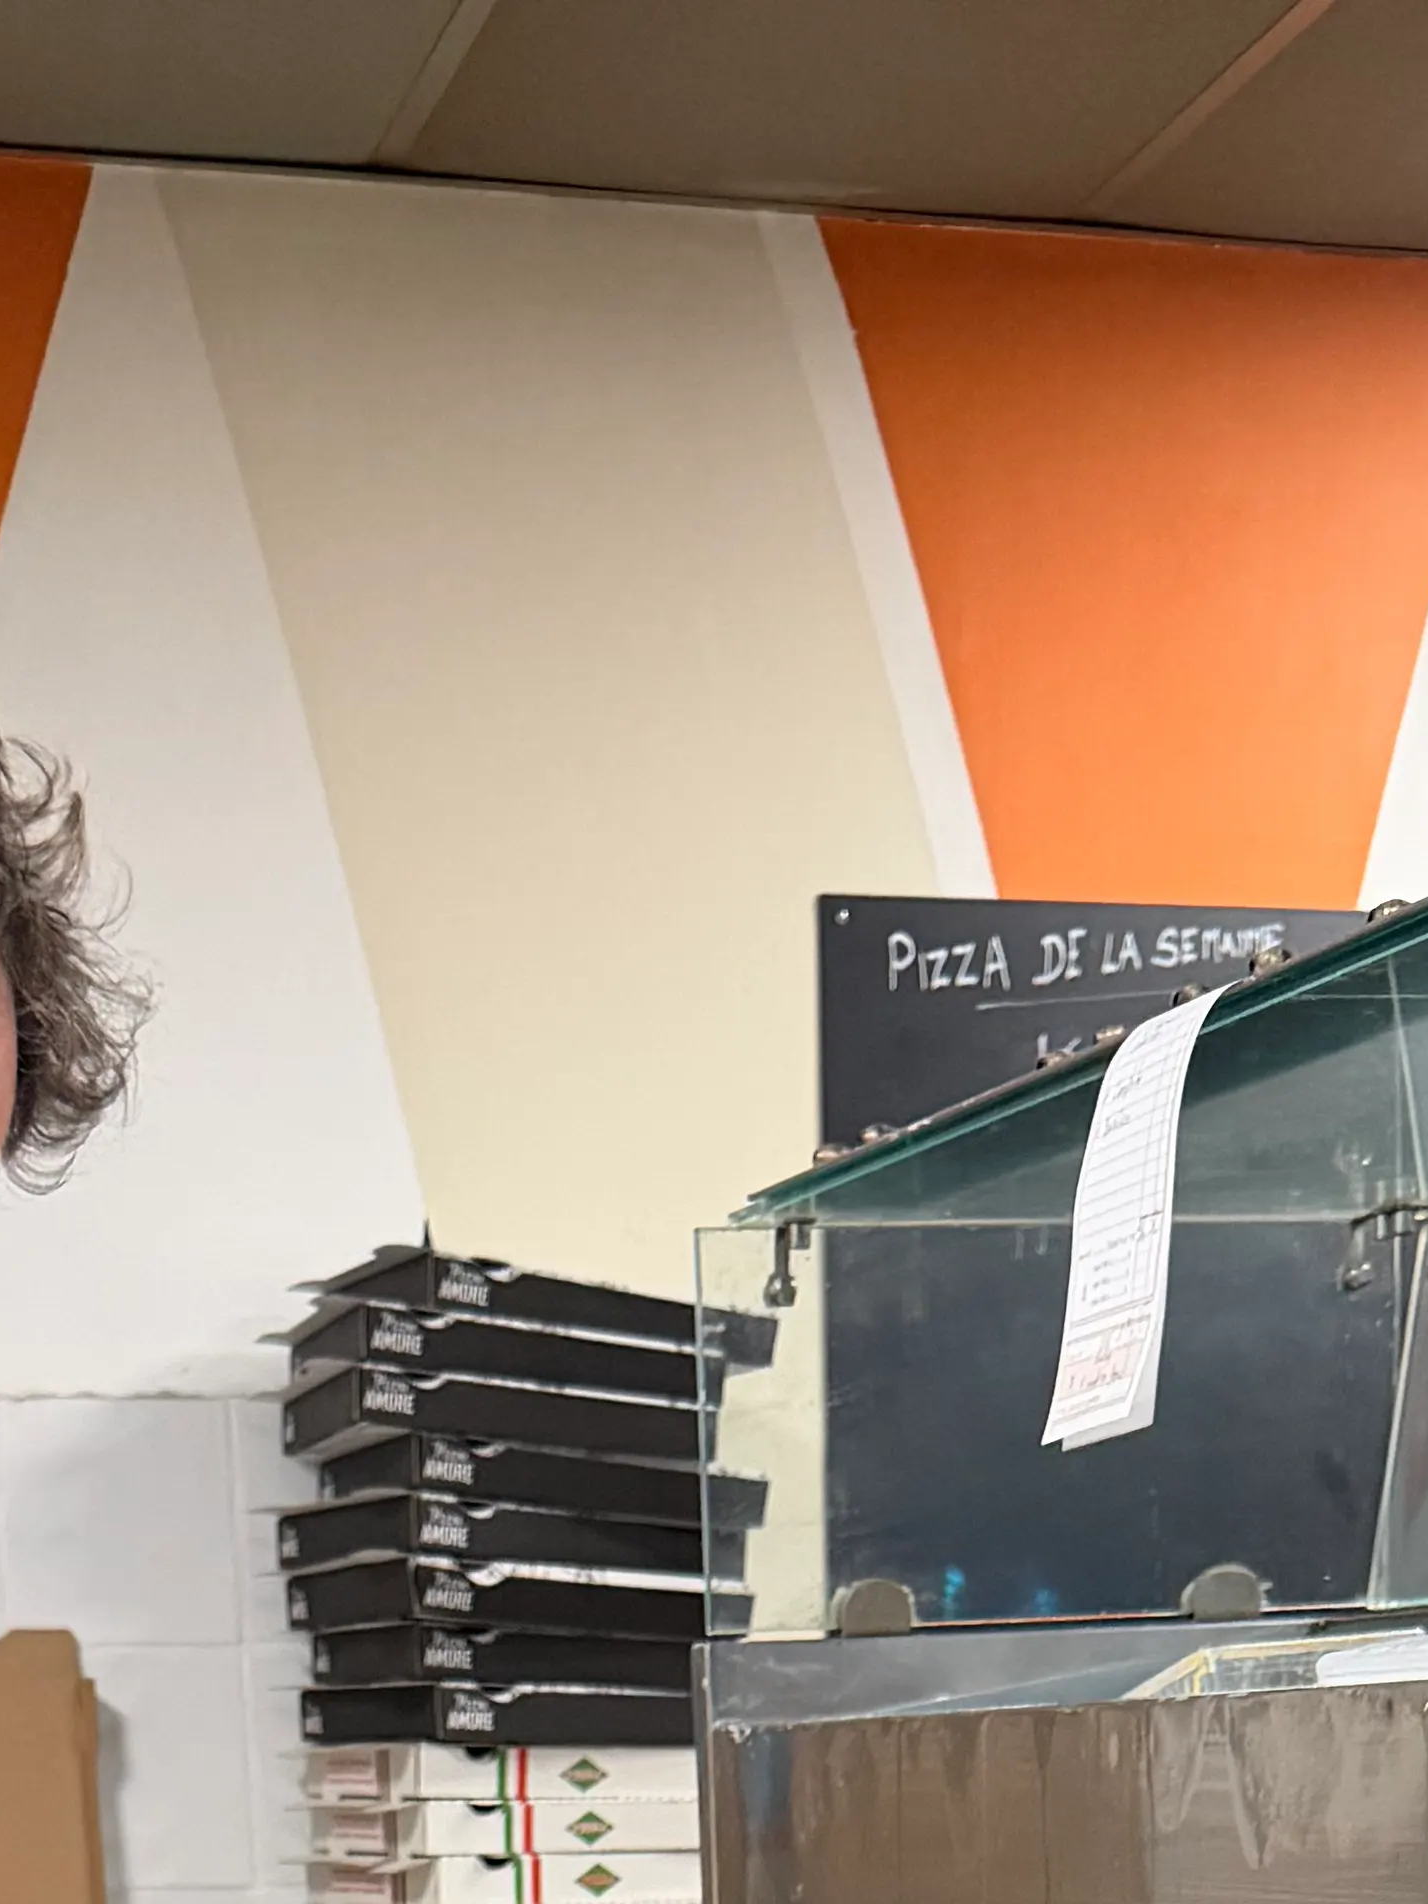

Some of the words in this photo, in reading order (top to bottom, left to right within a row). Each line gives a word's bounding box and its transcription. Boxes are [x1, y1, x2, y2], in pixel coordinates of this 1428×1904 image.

[887, 930, 1011, 991] PIZZA
[1032, 926, 1087, 986] DE
[1101, 930, 1142, 975] LA
